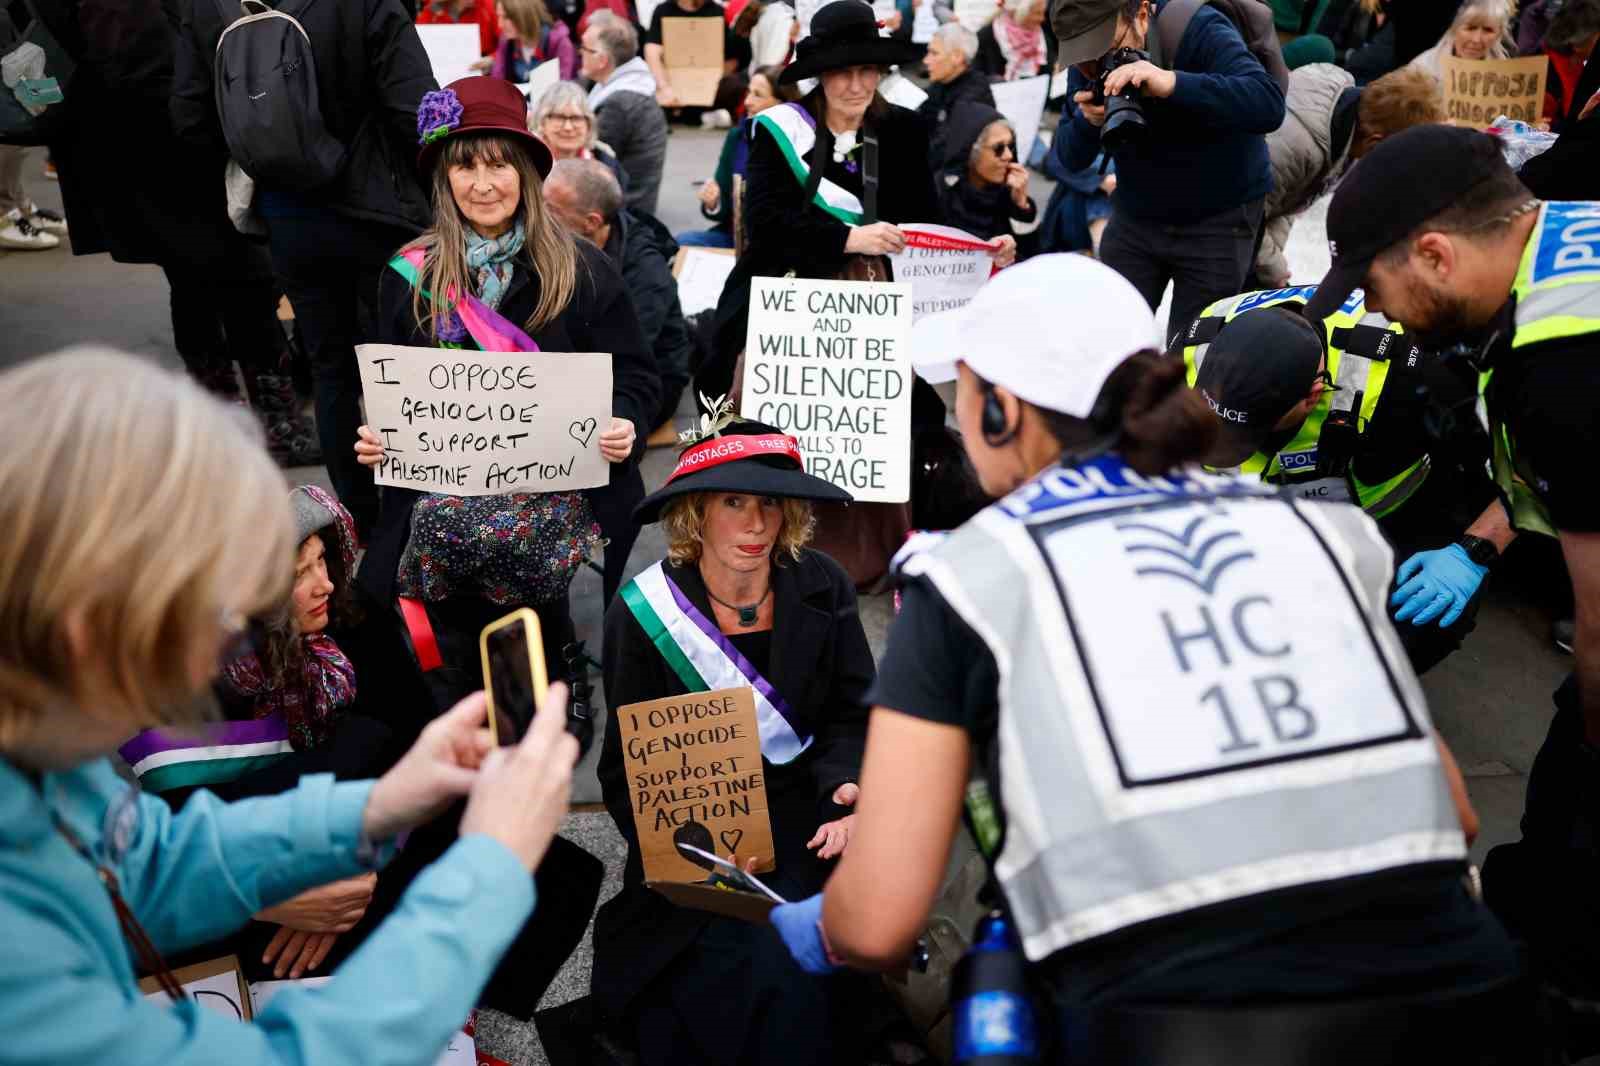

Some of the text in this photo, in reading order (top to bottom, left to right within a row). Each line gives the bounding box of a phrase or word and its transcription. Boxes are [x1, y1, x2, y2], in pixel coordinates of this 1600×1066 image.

[902, 262, 976, 278] GENOCIDE
[761, 289, 905, 317] WE CANNOT
[812, 318, 852, 334] AND
[759, 334, 896, 362] WILL NOT BE
[371, 357, 538, 393] I OPPOSE
[752, 363, 903, 400] SILENCED
[400, 396, 540, 426] GENOCIDE
[757, 401, 888, 435] COURAGE
[380, 428, 530, 453] I SUPPORT
[684, 440, 745, 467] HOSTAGES
[759, 438, 787, 450] FREE
[842, 437, 862, 455] TO
[377, 453, 575, 489] PALESTINE ACTION
[1304, 486, 1329, 497] HC
[1160, 595, 1292, 675] HC
[630, 696, 739, 731] I OPPOSE
[1200, 673, 1319, 755] 1B
[627, 723, 748, 766] GENOCIDE
[681, 752, 687, 767] I
[634, 756, 745, 789] SUPPORT
[637, 773, 764, 815] PALESTINE
[654, 795, 751, 832] ACTION
